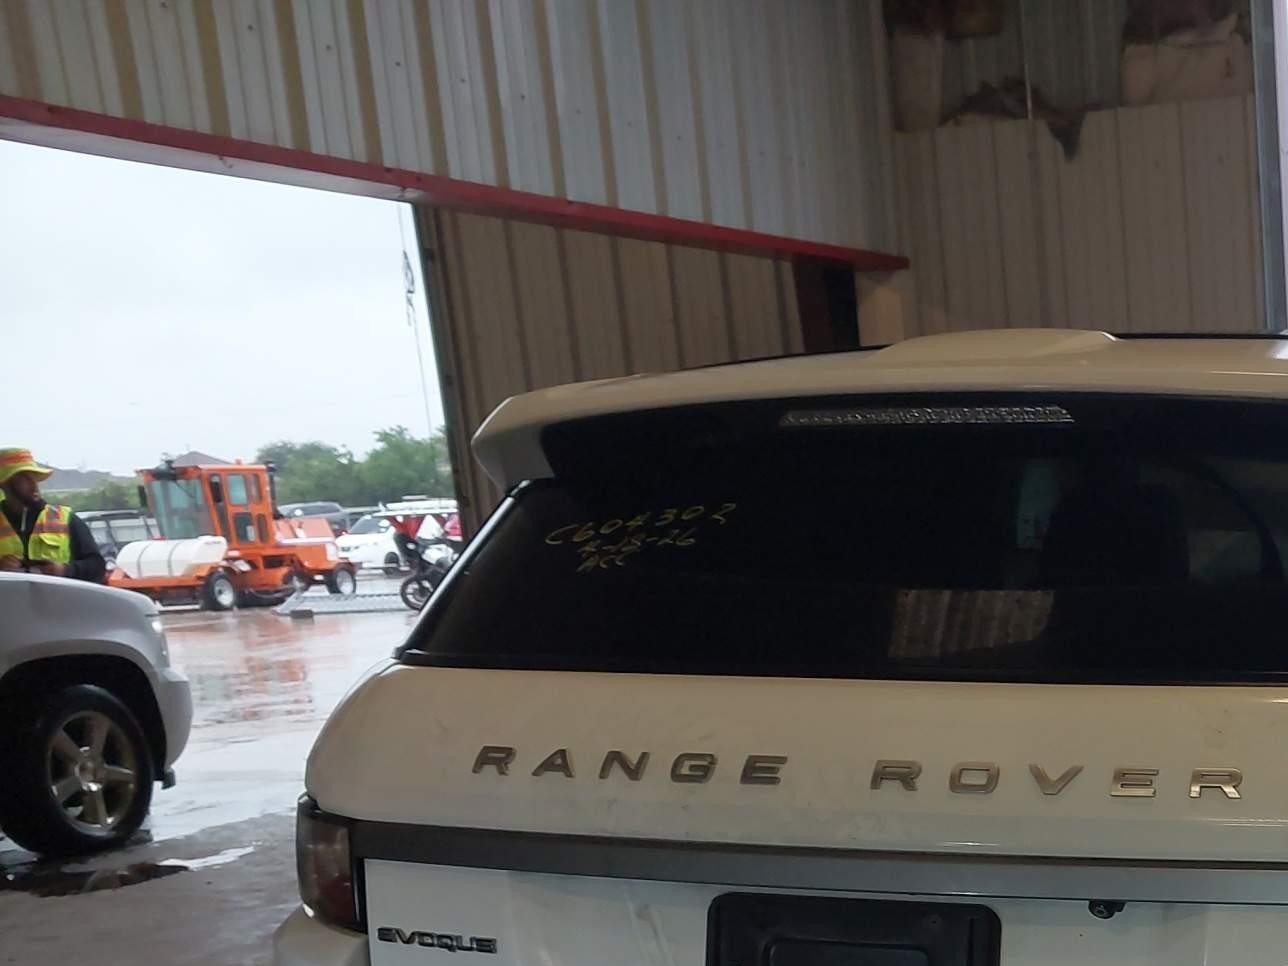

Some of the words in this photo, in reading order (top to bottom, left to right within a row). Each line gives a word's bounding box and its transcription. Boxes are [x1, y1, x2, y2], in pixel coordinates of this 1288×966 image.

[472, 745, 788, 785] RANGE
[870, 759, 1243, 800] ROVER
[377, 927, 498, 954] EVOQUE
